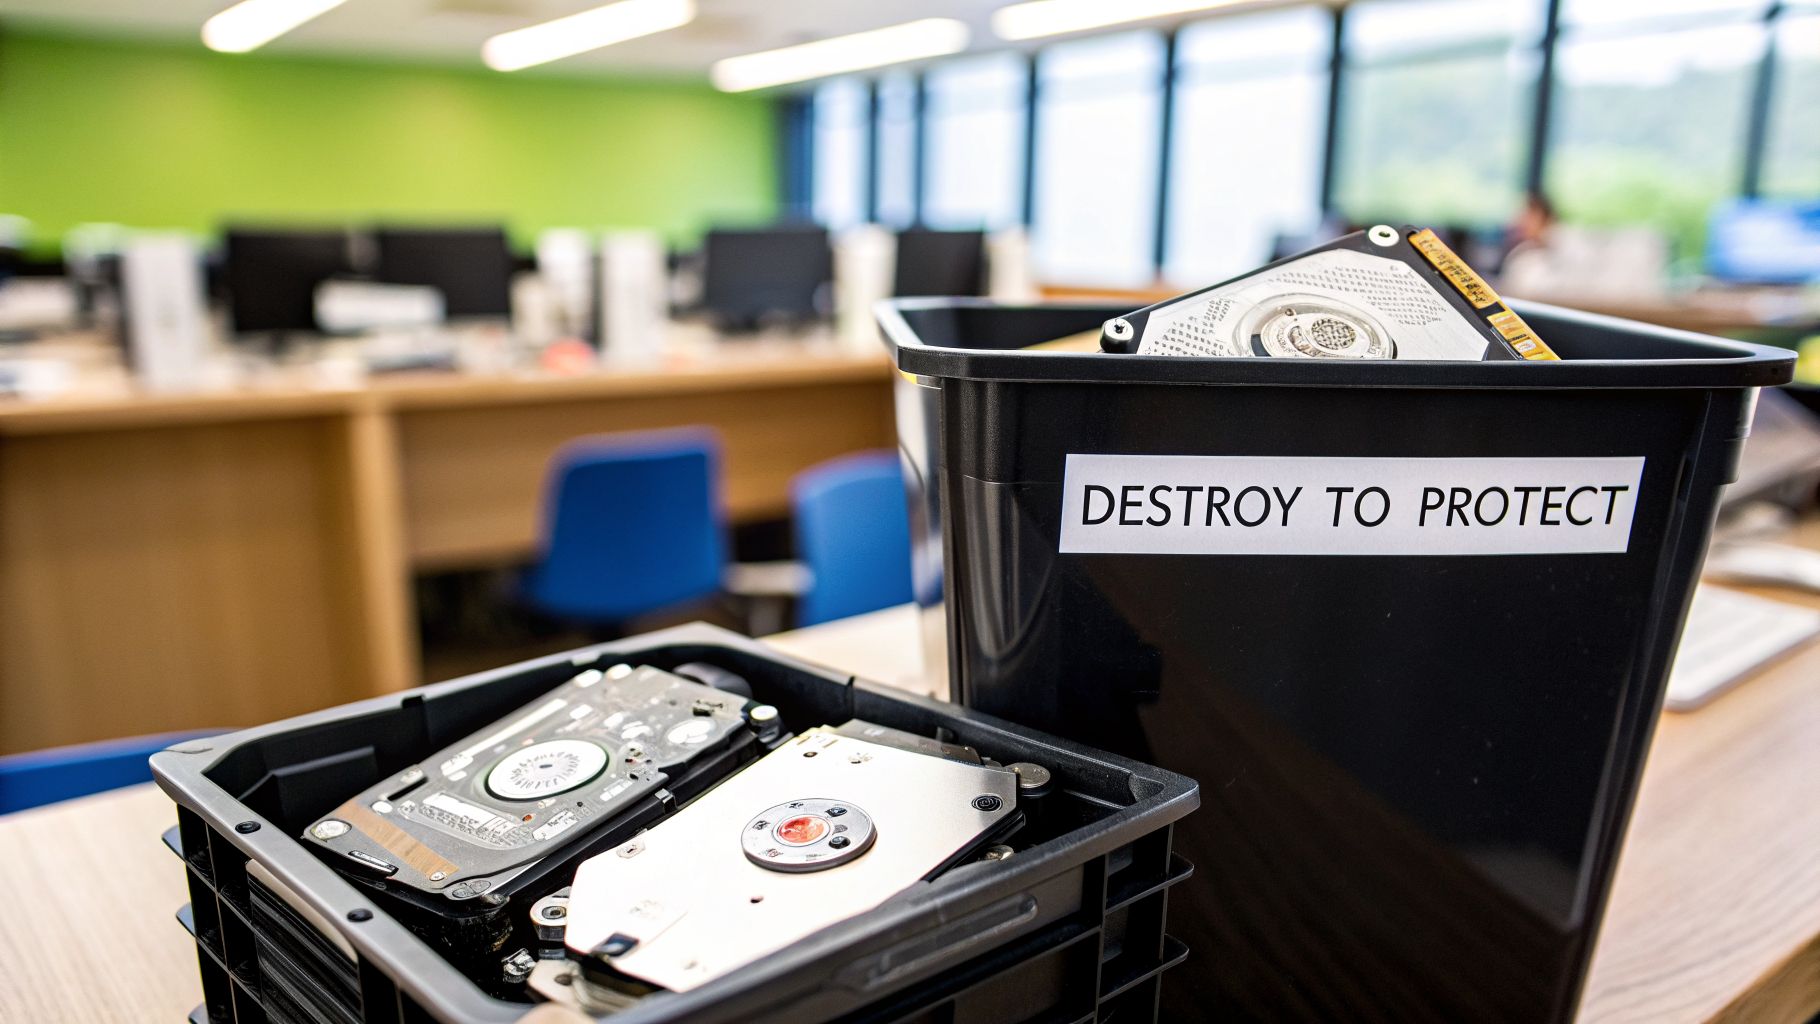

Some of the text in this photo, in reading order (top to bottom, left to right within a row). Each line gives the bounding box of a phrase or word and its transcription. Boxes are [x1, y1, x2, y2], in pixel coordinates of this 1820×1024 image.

[1082, 485, 1630, 527] DESTROY TO PROTECT
